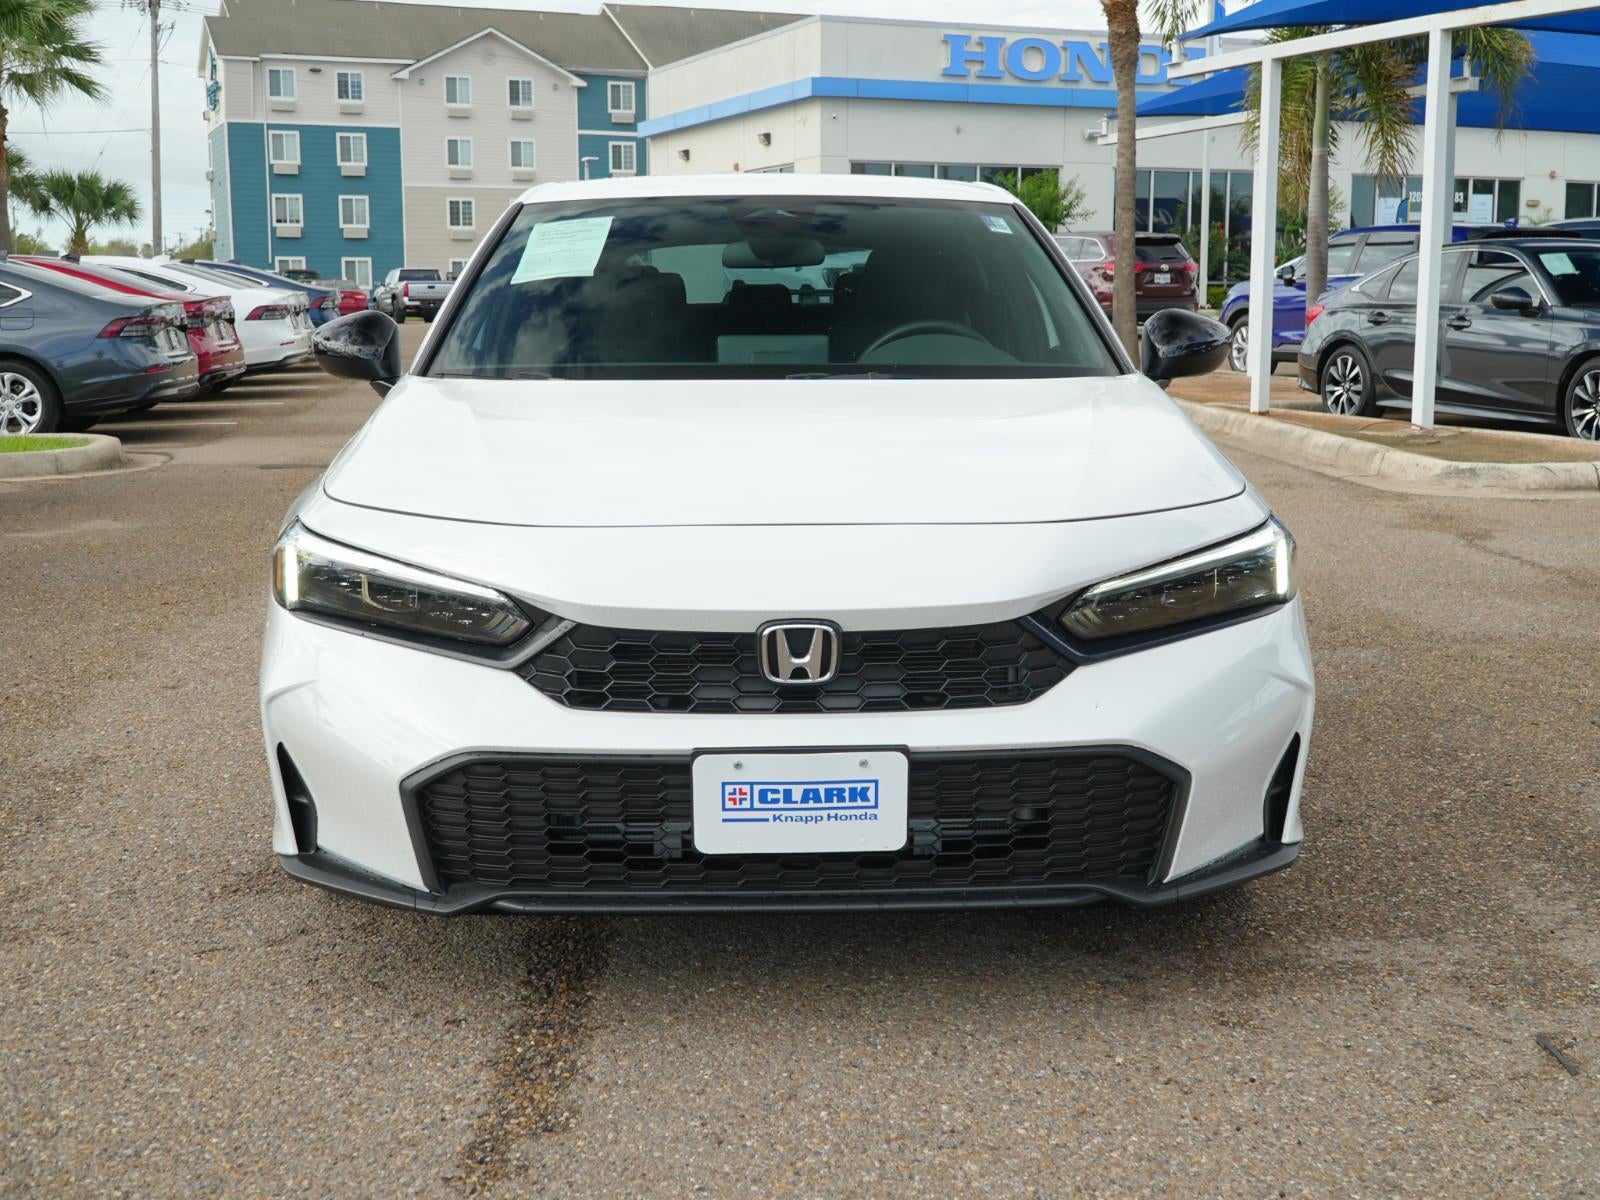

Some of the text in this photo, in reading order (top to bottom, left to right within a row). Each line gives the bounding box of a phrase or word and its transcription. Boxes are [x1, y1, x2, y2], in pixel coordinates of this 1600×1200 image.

[1454, 191, 1464, 203] 83
[758, 786, 871, 805] CLARK
[772, 811, 878, 824] Knapp Honda
